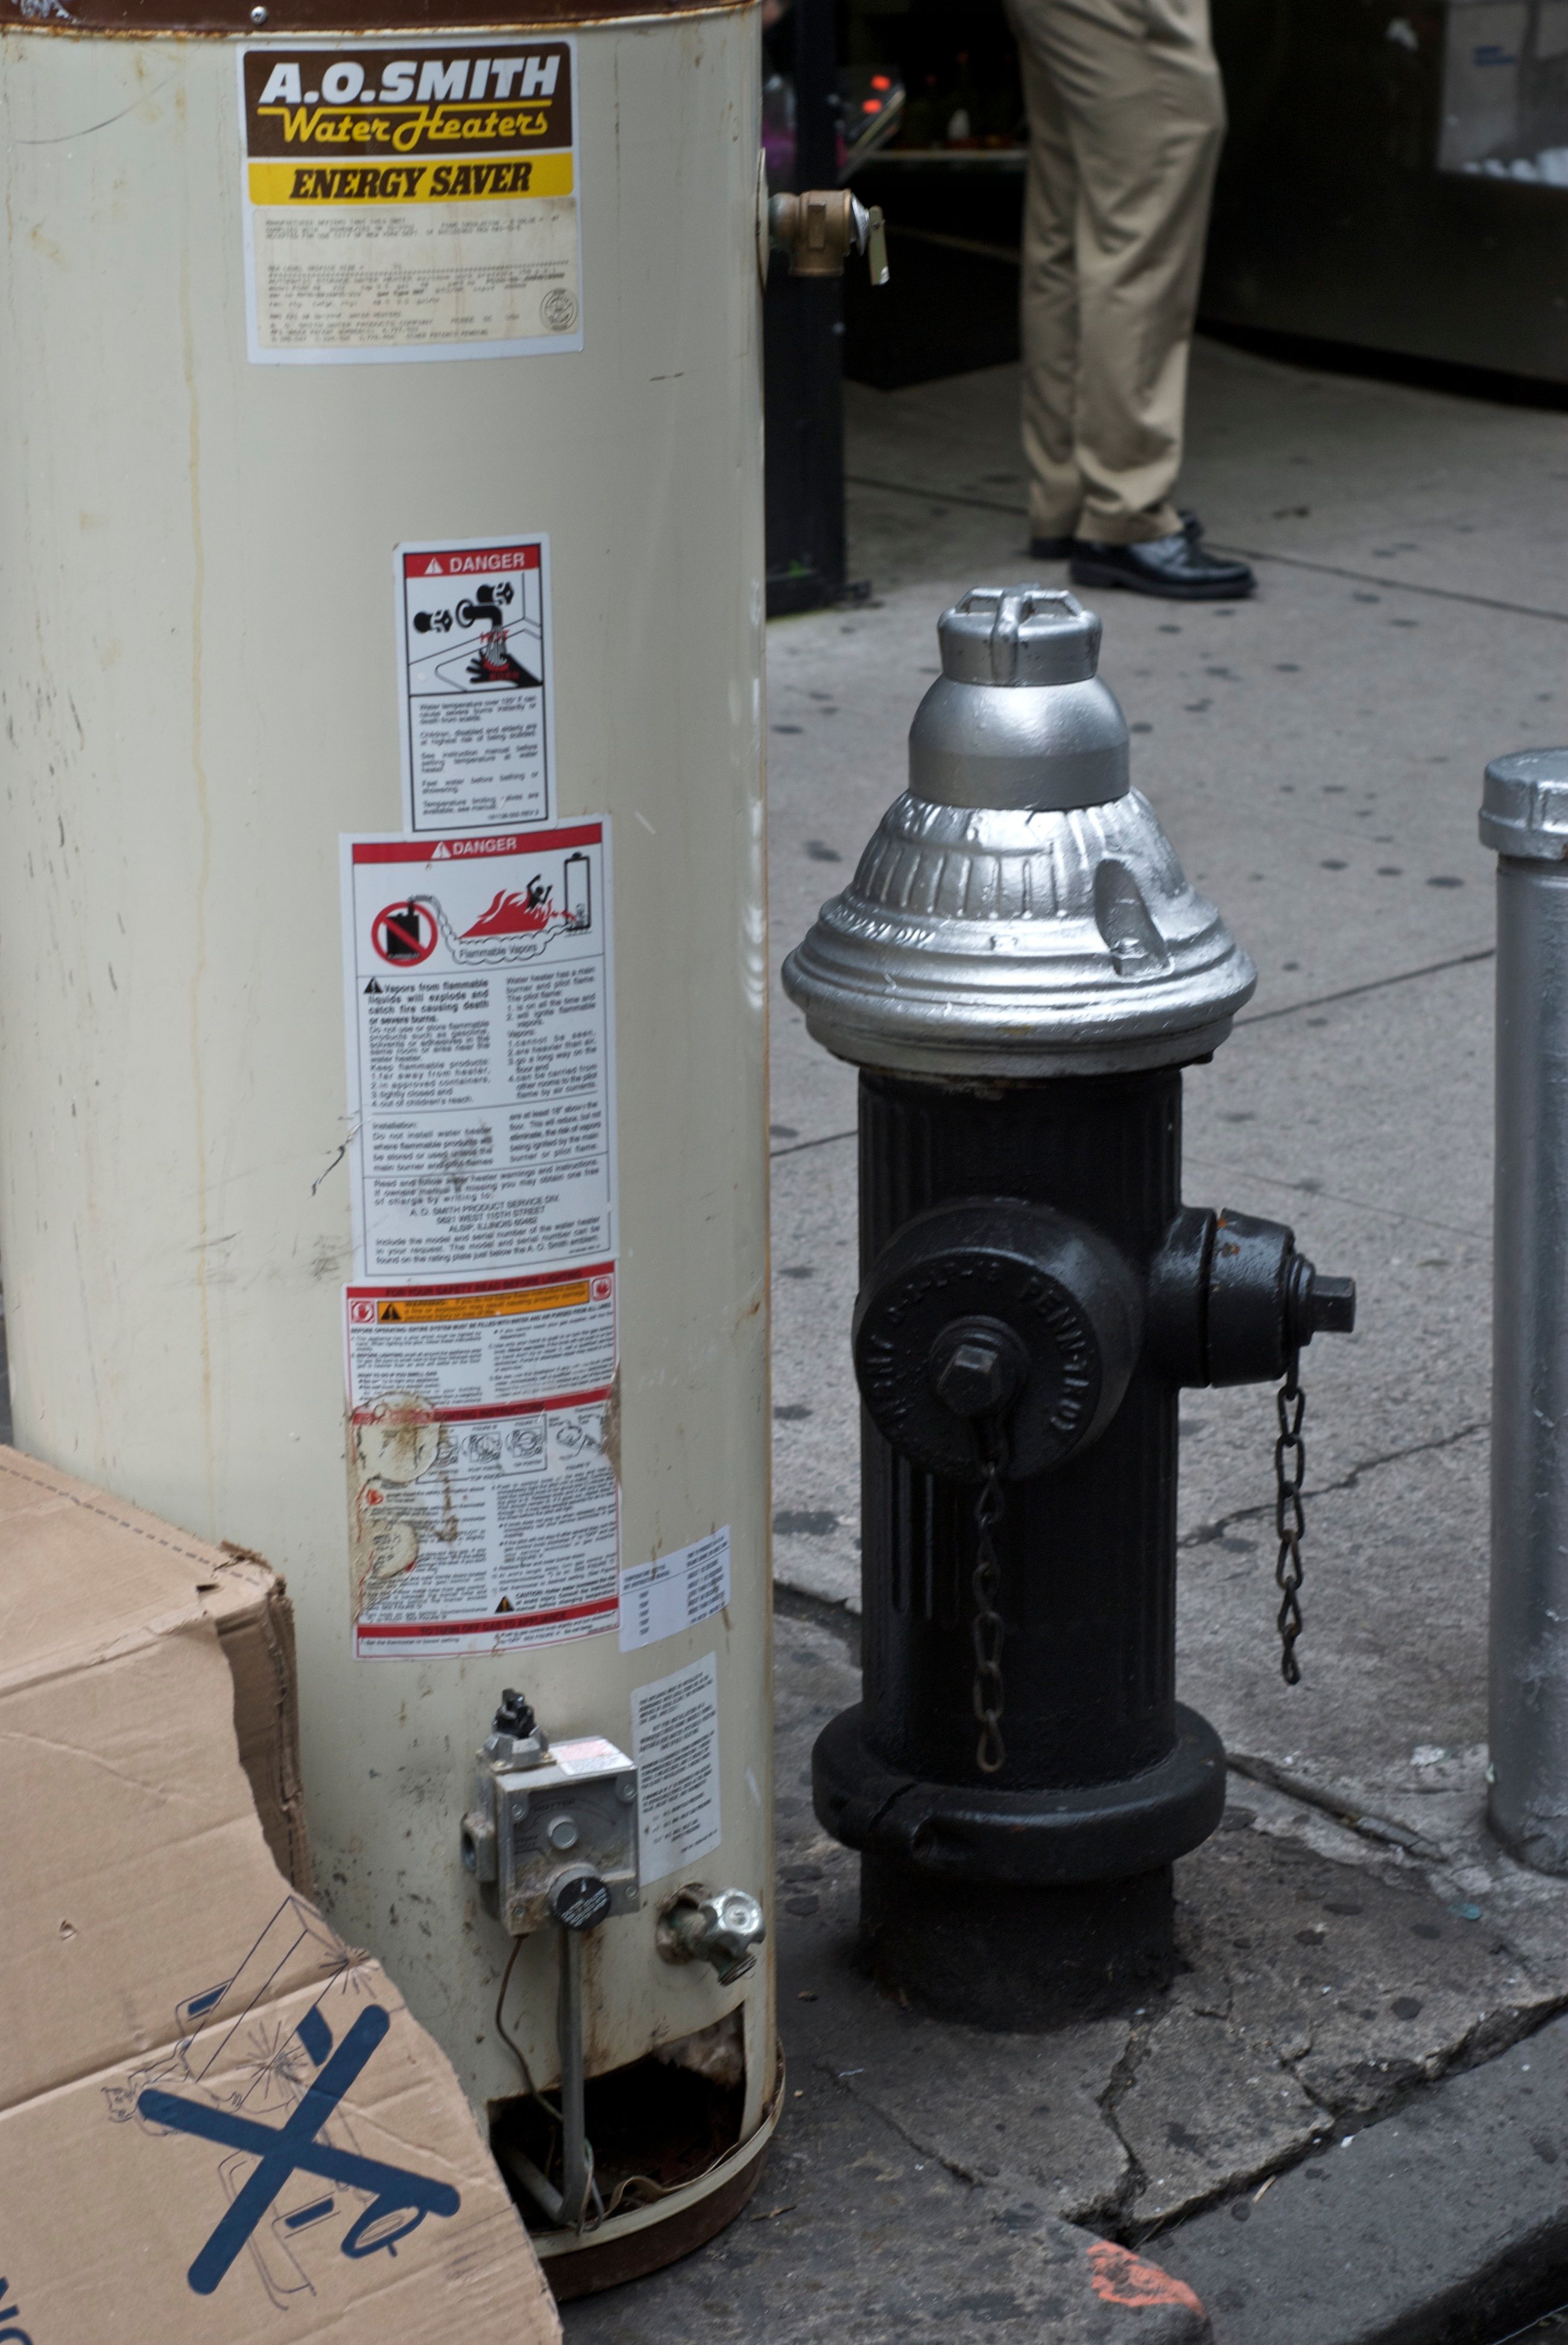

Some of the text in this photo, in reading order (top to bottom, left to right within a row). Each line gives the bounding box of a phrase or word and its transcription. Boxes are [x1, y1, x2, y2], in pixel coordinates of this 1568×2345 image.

[258, 55, 561, 104] A.O.SMITH
[258, 100, 552, 152] Water Heaters
[289, 161, 533, 200] ENERGY SAVER
[449, 552, 525, 573] DANGER
[453, 837, 517, 855] DANGER
[460, 943, 537, 958] Flammable Vapors
[384, 984, 416, 994] Vapors
[443, 980, 488, 989] flammable
